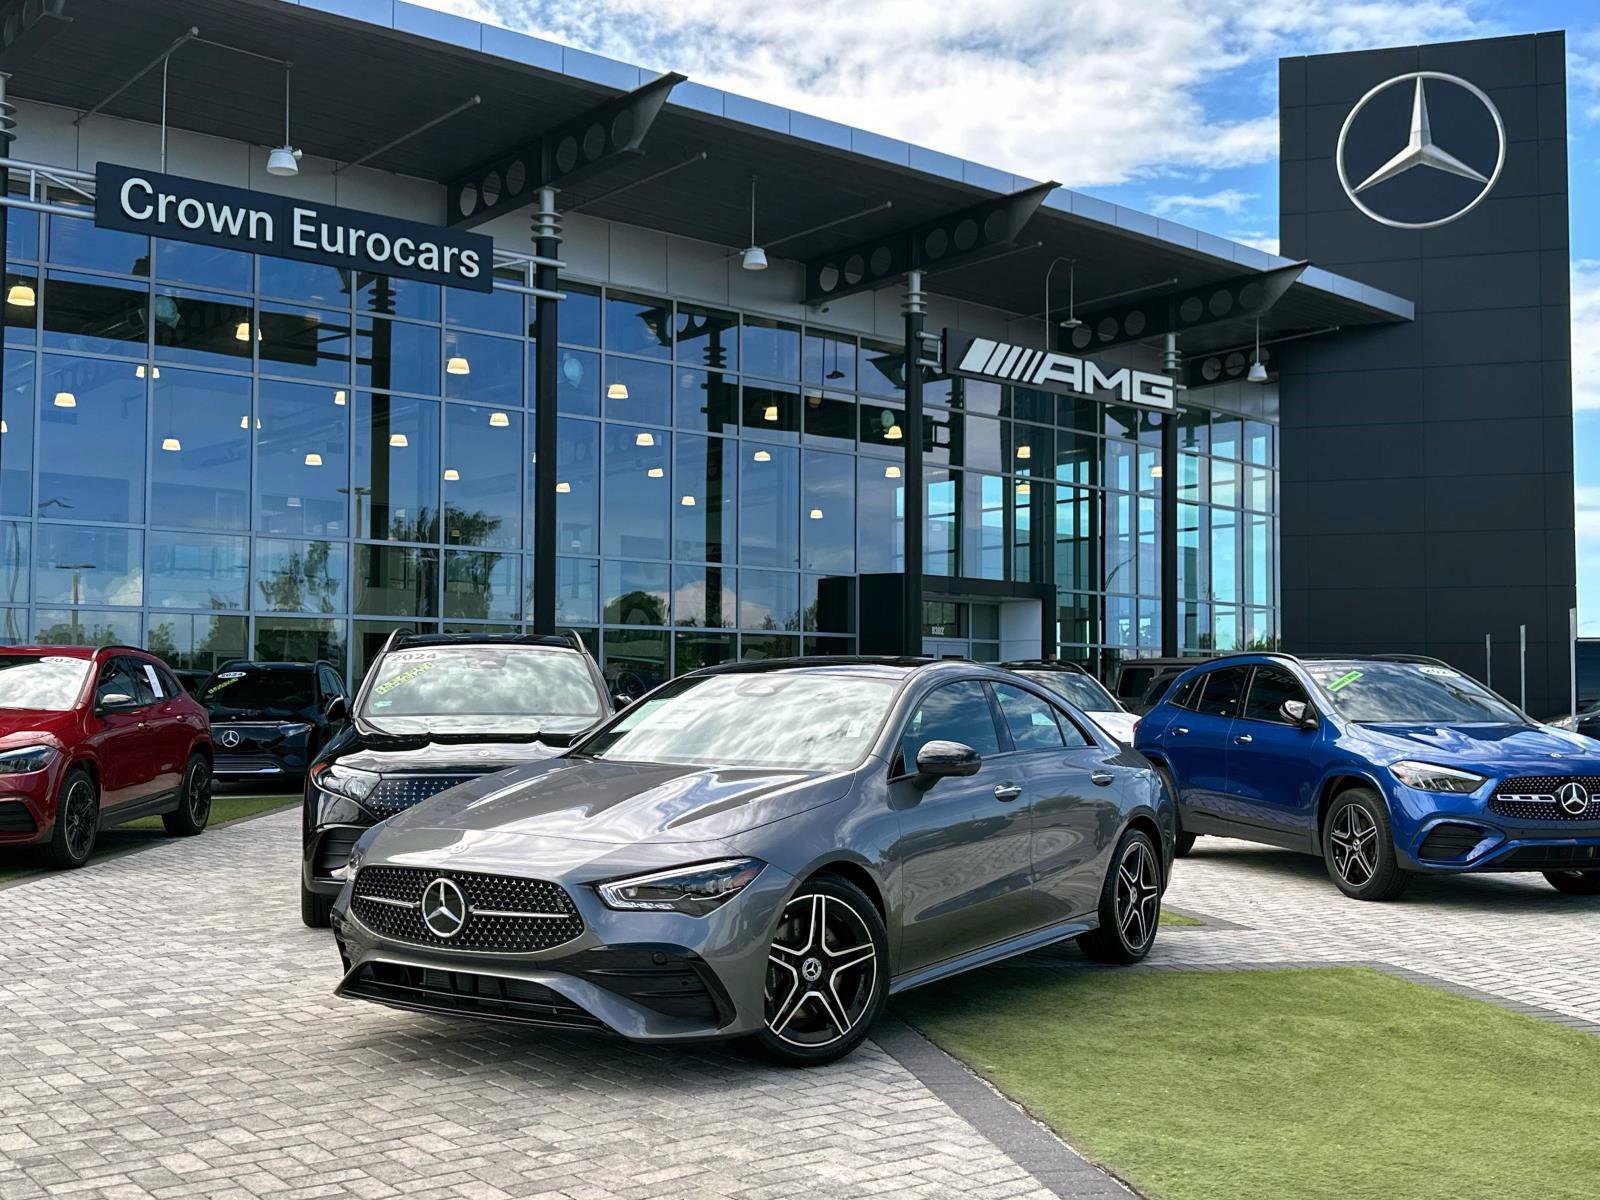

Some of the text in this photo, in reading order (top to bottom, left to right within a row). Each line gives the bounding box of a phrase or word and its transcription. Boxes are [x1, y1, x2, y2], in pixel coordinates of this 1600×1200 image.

[120, 177, 481, 279] Crown Eurocars
[1032, 352, 1174, 409] AMG
[391, 653, 437, 661] 2024
